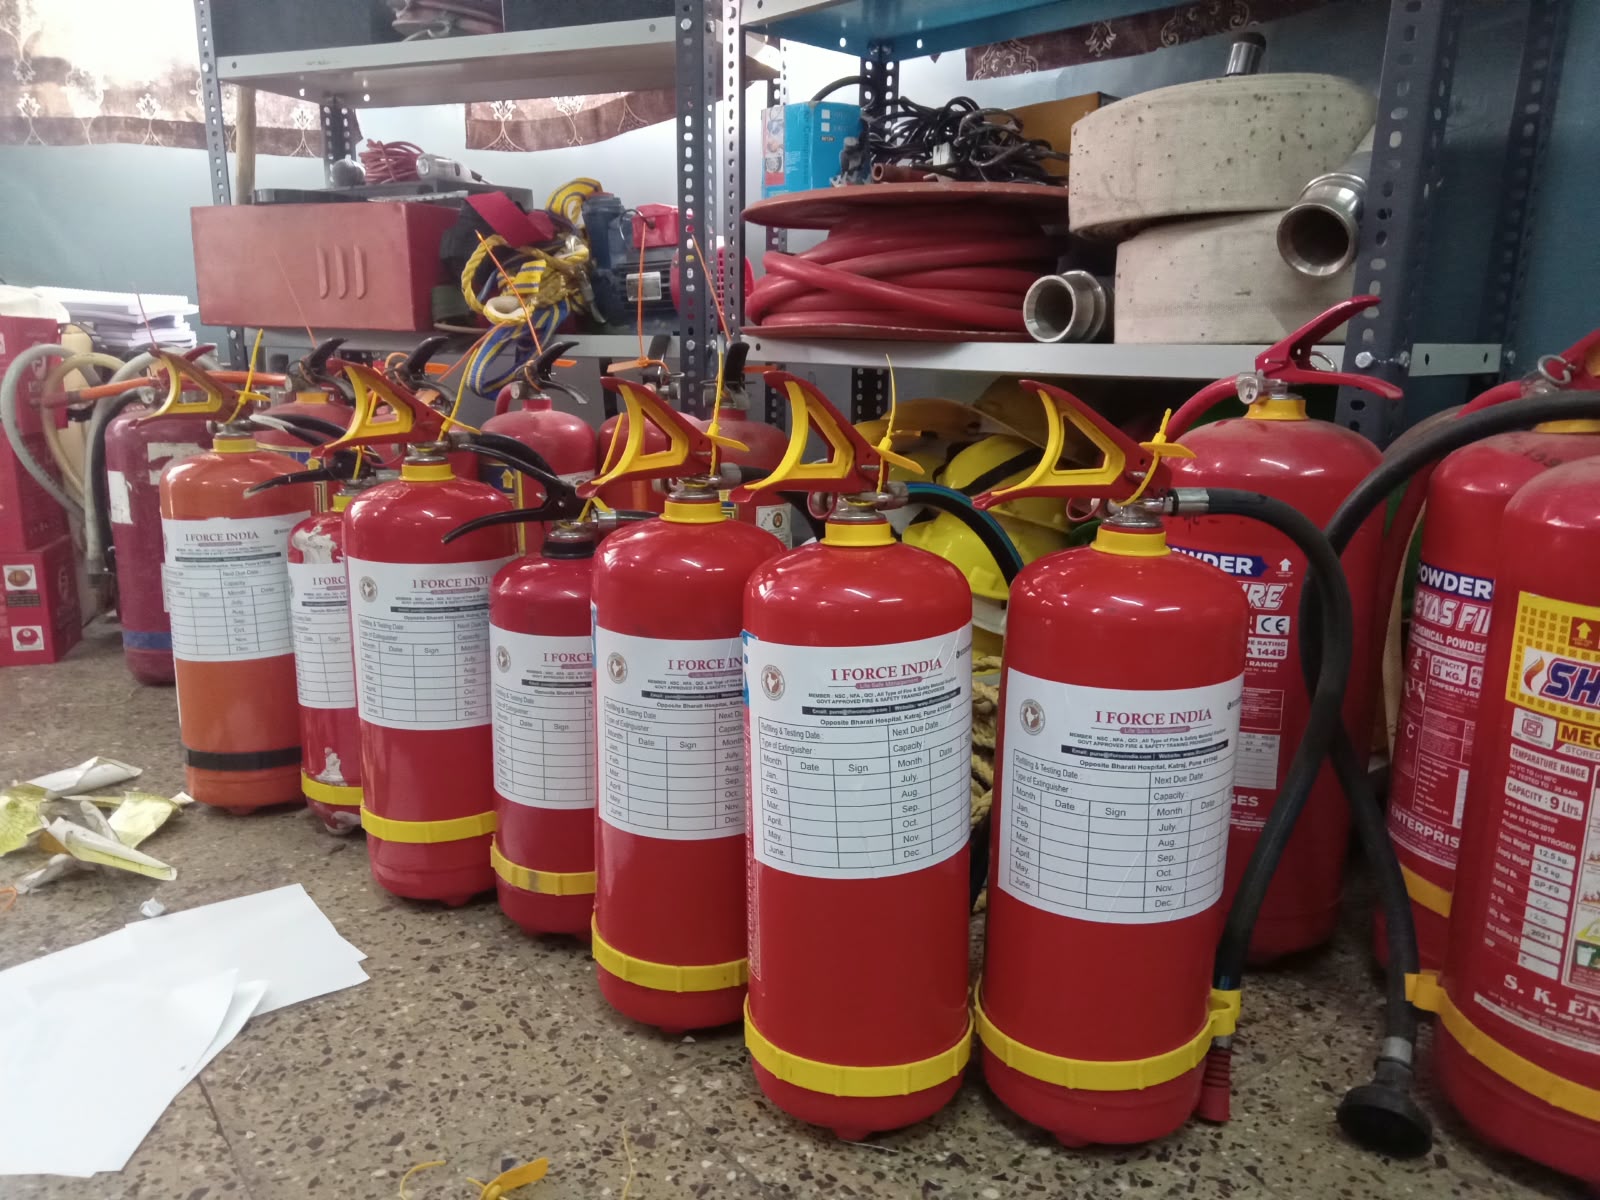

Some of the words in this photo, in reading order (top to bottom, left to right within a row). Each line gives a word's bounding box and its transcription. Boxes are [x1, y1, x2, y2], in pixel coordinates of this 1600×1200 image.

[190, 533, 224, 542] FORCE
[226, 531, 260, 540] INDIA
[318, 576, 346, 586] FORC
[420, 578, 461, 589] FORCE
[464, 576, 489, 587] INDI
[1260, 617, 1286, 633] CE
[551, 652, 593, 662] FORCE
[1257, 648, 1286, 656] 144B
[668, 660, 673, 670] I
[678, 658, 725, 670] FORCE
[831, 668, 838, 680] I
[842, 666, 897, 680] FORCE
[902, 658, 942, 676] INDIA
[1544, 662, 1600, 704] SH
[1096, 710, 1102, 722] I
[1106, 712, 1166, 725] FORCE
[1170, 708, 1212, 724] INDIA
[784, 728, 804, 740] Testing
[805, 731, 820, 740] Date
[892, 727, 909, 737] Next
[910, 724, 924, 734] Due
[924, 720, 939, 730] Date
[638, 738, 655, 746] Date
[680, 741, 697, 750] Sign
[778, 742, 812, 755] Extinguisher
[893, 740, 922, 753] Capacity
[763, 754, 782, 766] Month
[800, 762, 820, 772] Date
[848, 763, 869, 774] Sign
[898, 756, 922, 768] Month
[939, 747, 953, 758] Date
[1080, 760, 1110, 769] Opposite
[1112, 762, 1136, 770] Bharati
[1512, 747, 1558, 770] TEMPARATURE
[1560, 764, 1586, 778] RANGE
[1040, 764, 1062, 778] Testing
[1062, 768, 1078, 780] Date
[1154, 776, 1172, 785] Next
[1174, 774, 1188, 783] Due
[1188, 772, 1204, 782] Date
[1033, 777, 1069, 794] Extinguisher
[1016, 786, 1036, 800] Month
[1054, 799, 1076, 811] Date
[1104, 807, 1127, 818] Sign
[1156, 806, 1183, 816] Month
[1154, 792, 1184, 801] Capacity
[1507, 782, 1542, 802] CAPACITY
[1550, 796, 1560, 810] 9
[1504, 974, 1524, 994] S.
[1534, 986, 1558, 1008] K.
